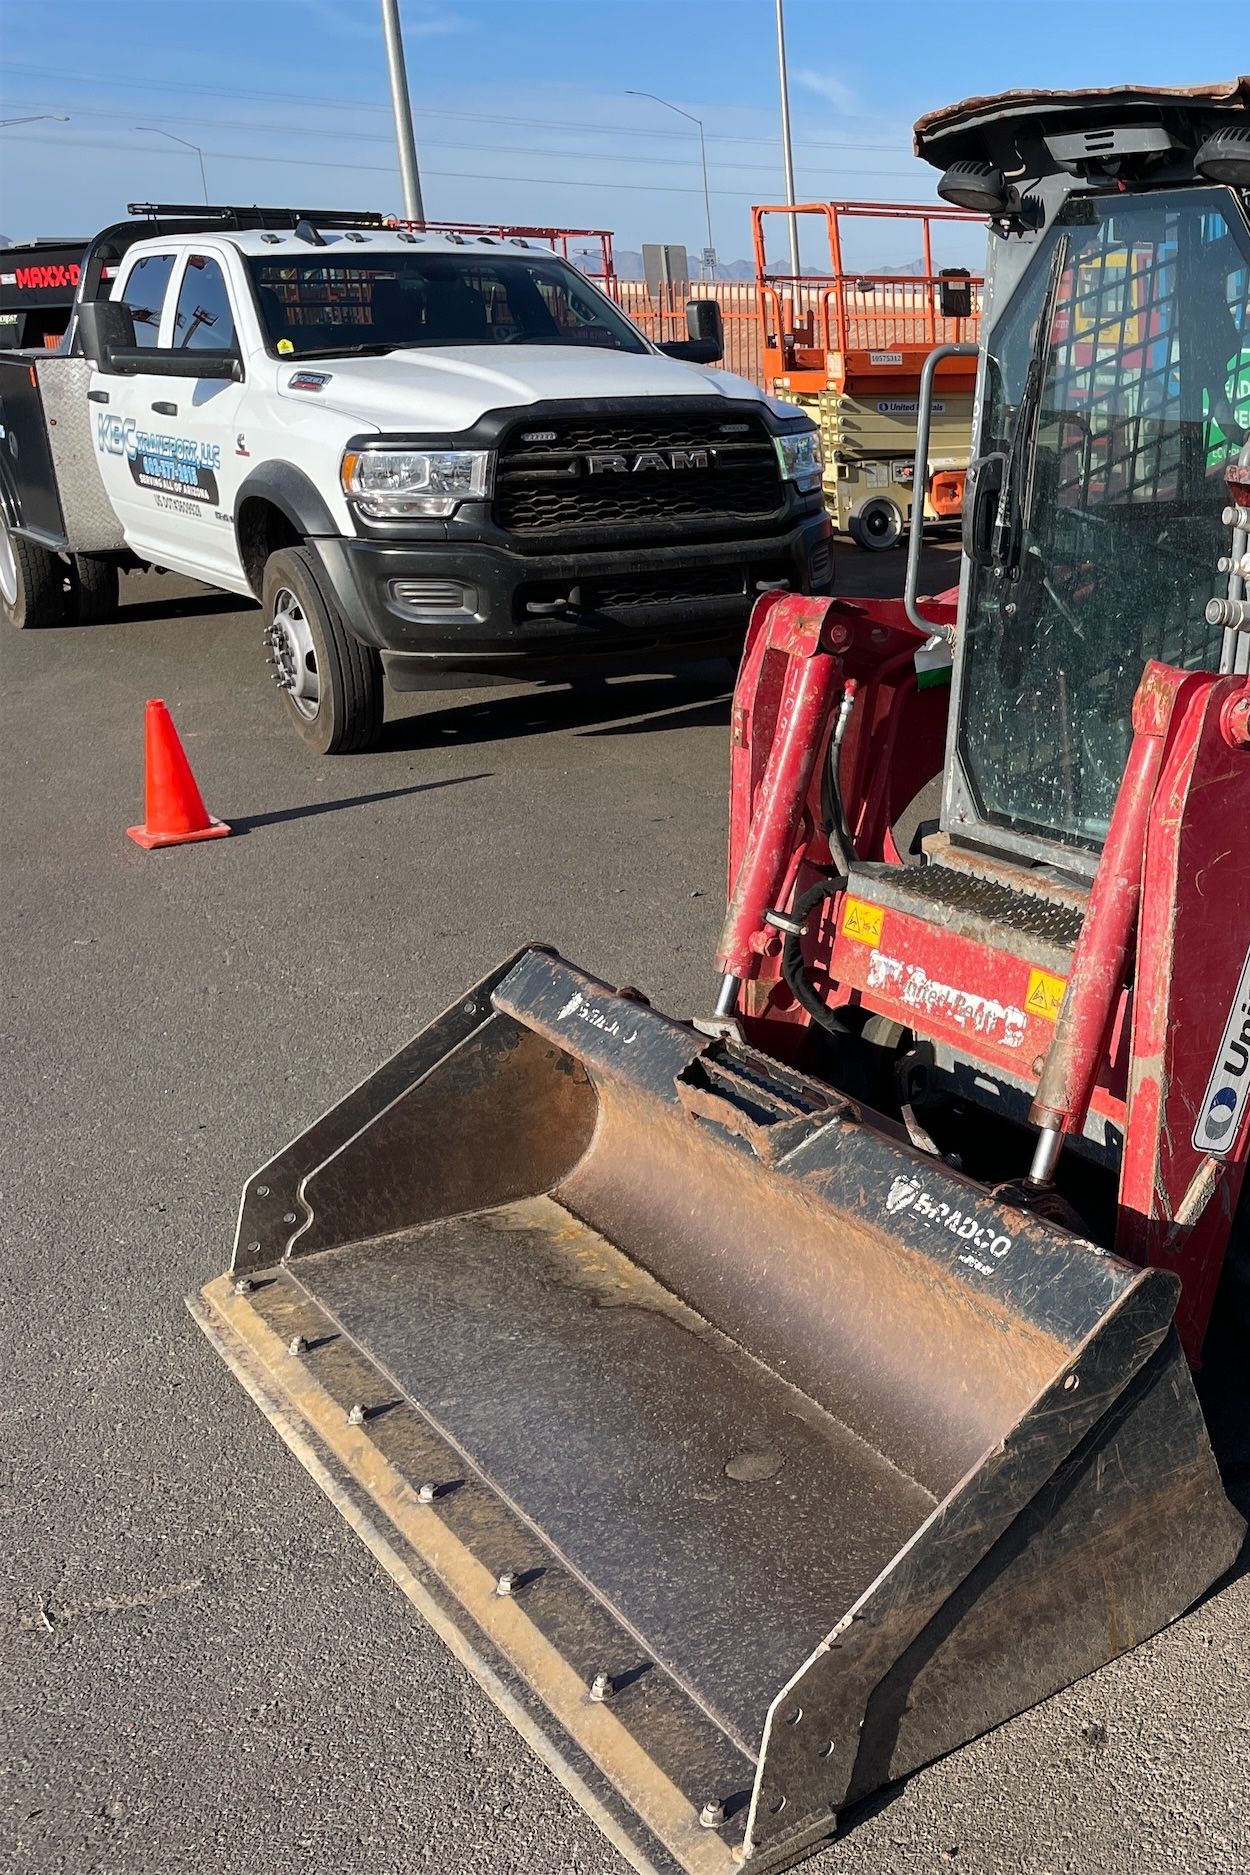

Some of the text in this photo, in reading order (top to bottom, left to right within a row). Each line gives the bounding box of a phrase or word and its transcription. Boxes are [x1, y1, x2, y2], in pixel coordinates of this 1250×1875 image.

[16, 264, 81, 288] MAXX-D
[890, 403, 916, 411] United
[98, 413, 137, 461] KBC
[200, 442, 220, 470] LLC
[586, 450, 709, 475] RAM
[163, 479, 174, 490] ALL
